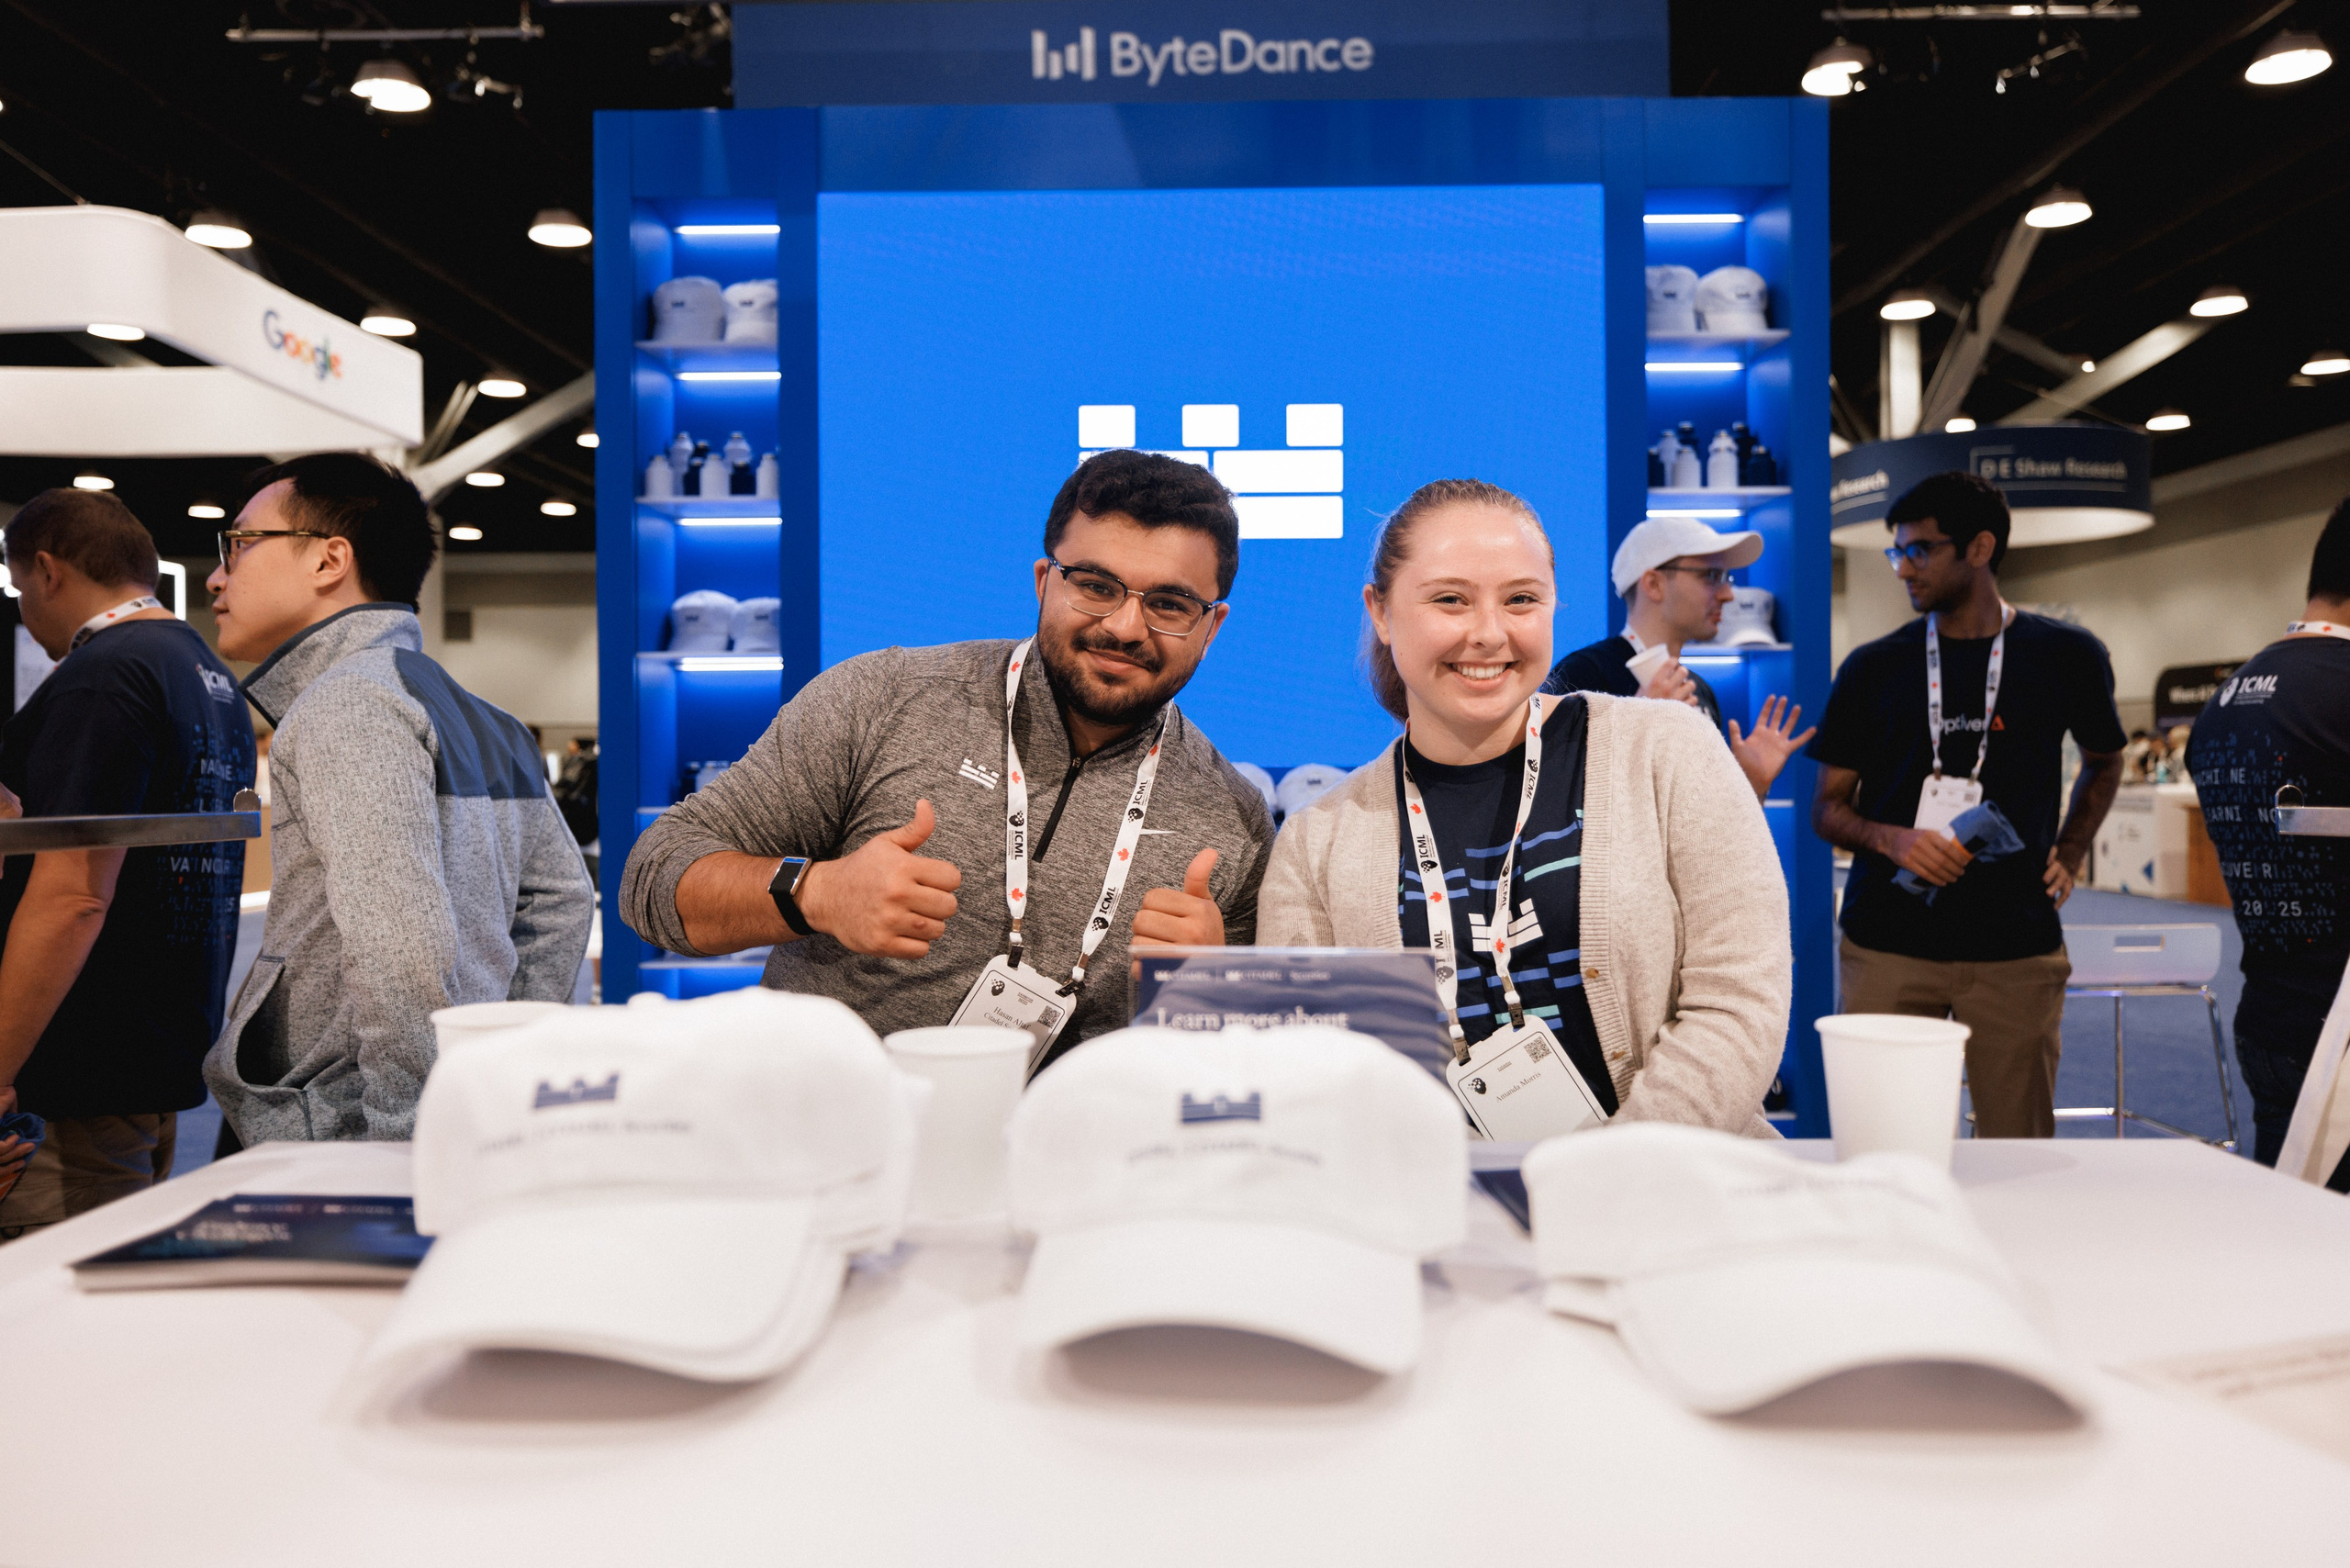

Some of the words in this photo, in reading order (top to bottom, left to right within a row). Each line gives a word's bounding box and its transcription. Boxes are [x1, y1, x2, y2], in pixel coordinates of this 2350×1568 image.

[1110, 28, 1374, 86] ByteDance
[263, 309, 342, 380] Google
[2238, 675, 2278, 694] ICML
[1133, 778, 1148, 806] ICML
[1527, 773, 1536, 800] ICML
[1014, 830, 1024, 861] ICML
[1416, 834, 1429, 858] ICML
[1099, 886, 1116, 915] ICML
[2277, 901, 2302, 917] 25
[1434, 930, 1446, 963] IML
[983, 1012, 1004, 1026] Citadel
[993, 1006, 1013, 1022] Hasan
[1157, 1007, 1221, 1031] Learn
[1285, 1005, 1349, 1029] about
[1496, 1085, 1521, 1103] Amanda
[1520, 1072, 1541, 1087] Morris
